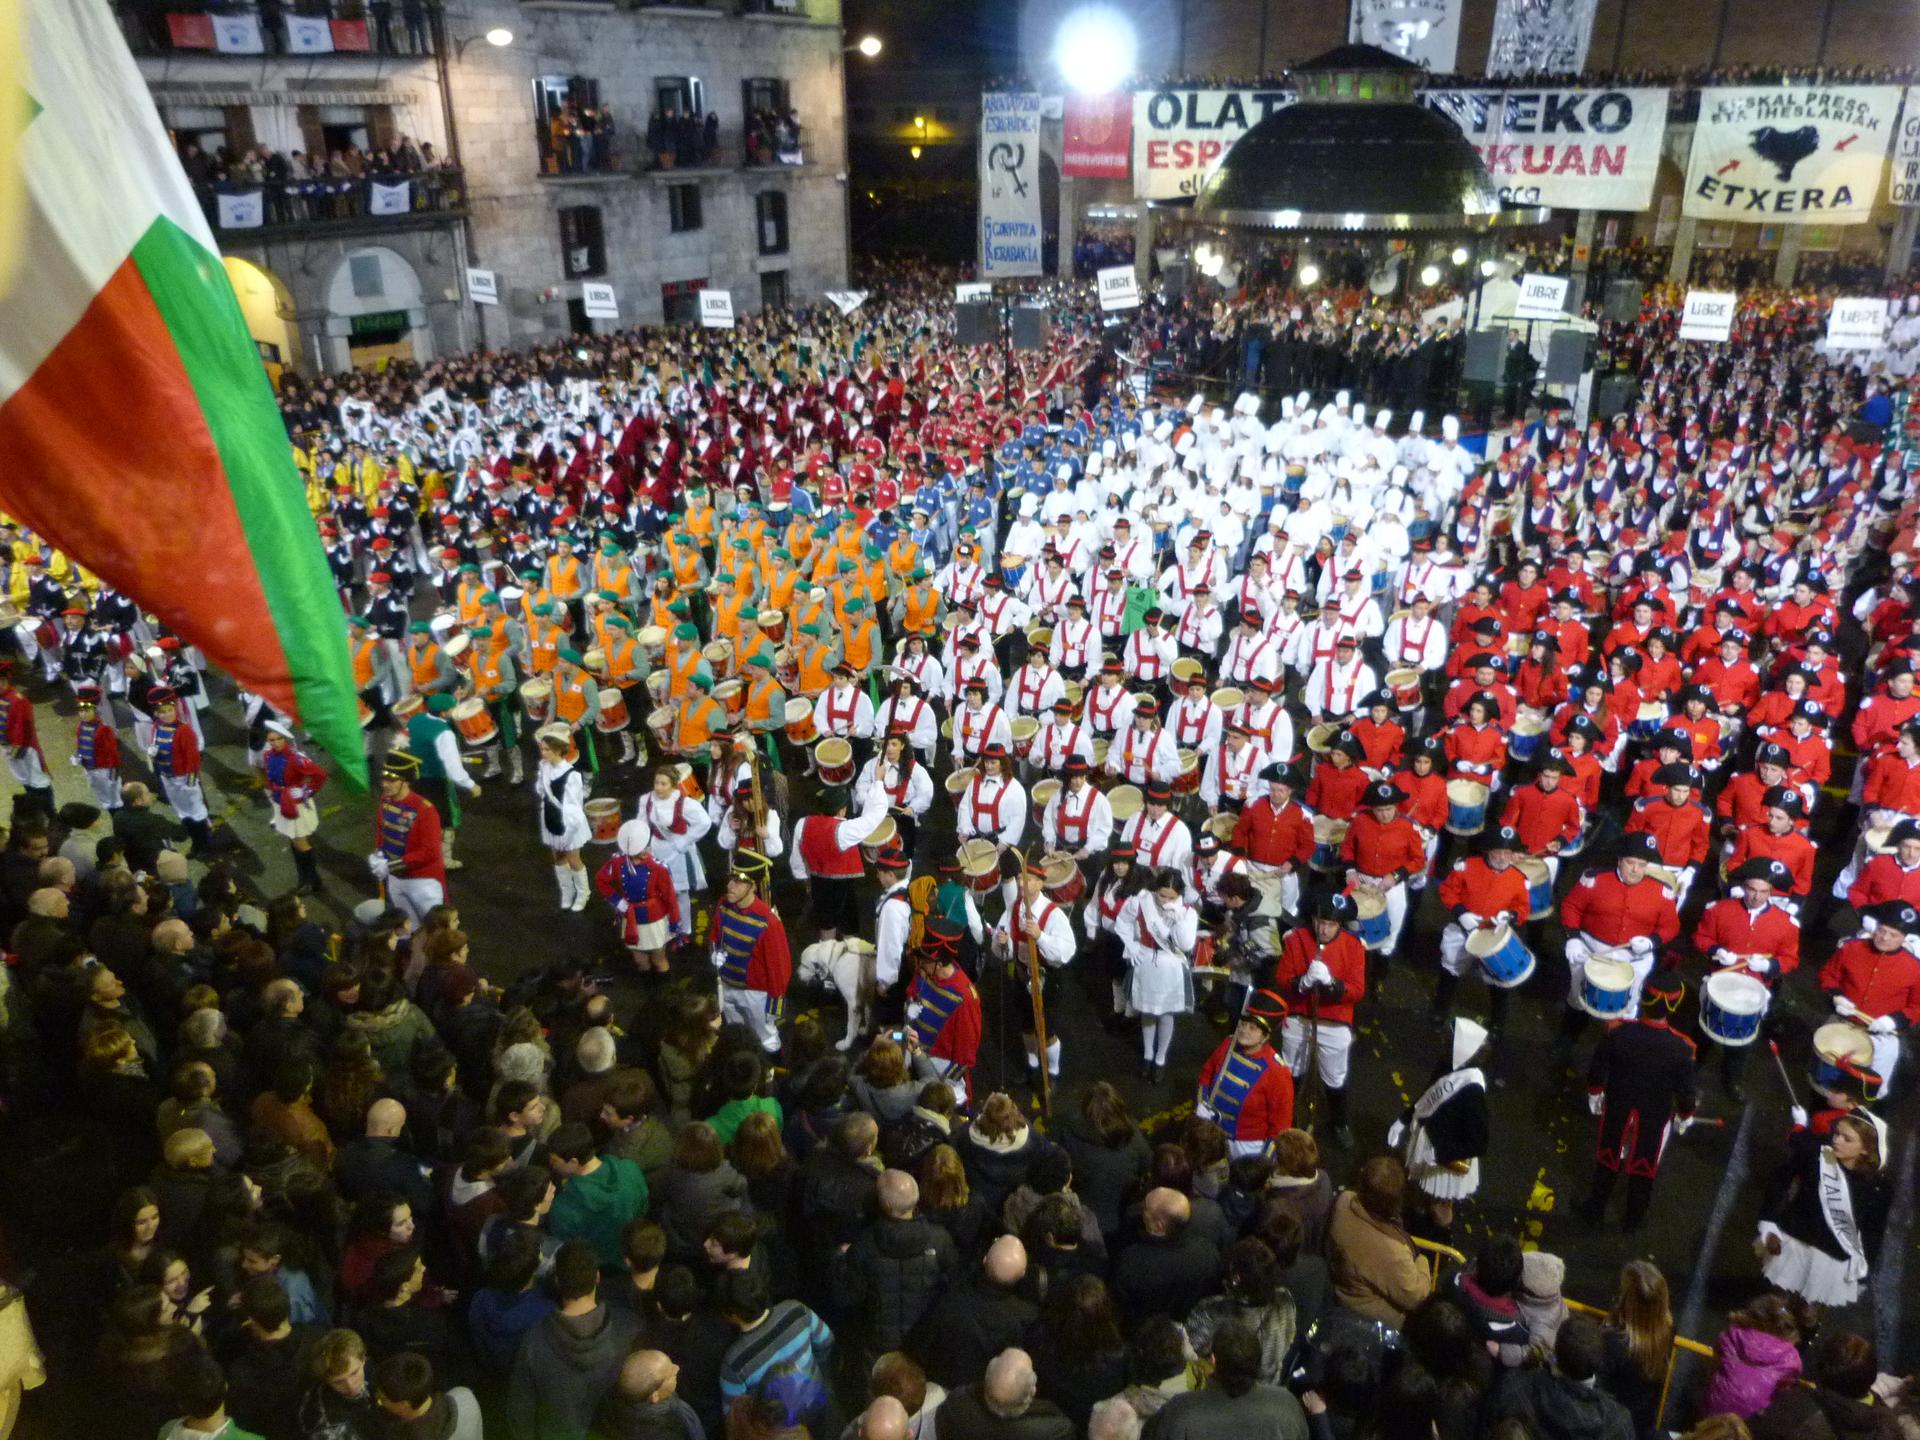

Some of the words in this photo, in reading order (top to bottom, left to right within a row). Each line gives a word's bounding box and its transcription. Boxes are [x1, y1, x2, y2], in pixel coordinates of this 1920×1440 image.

[1696, 174, 1853, 214] ETXERA
[1104, 277, 1132, 291] LIBRE
[1527, 283, 1560, 300] LIBRE
[1690, 301, 1727, 317] LIBRE
[1822, 1171, 1851, 1238] ZALEAK
